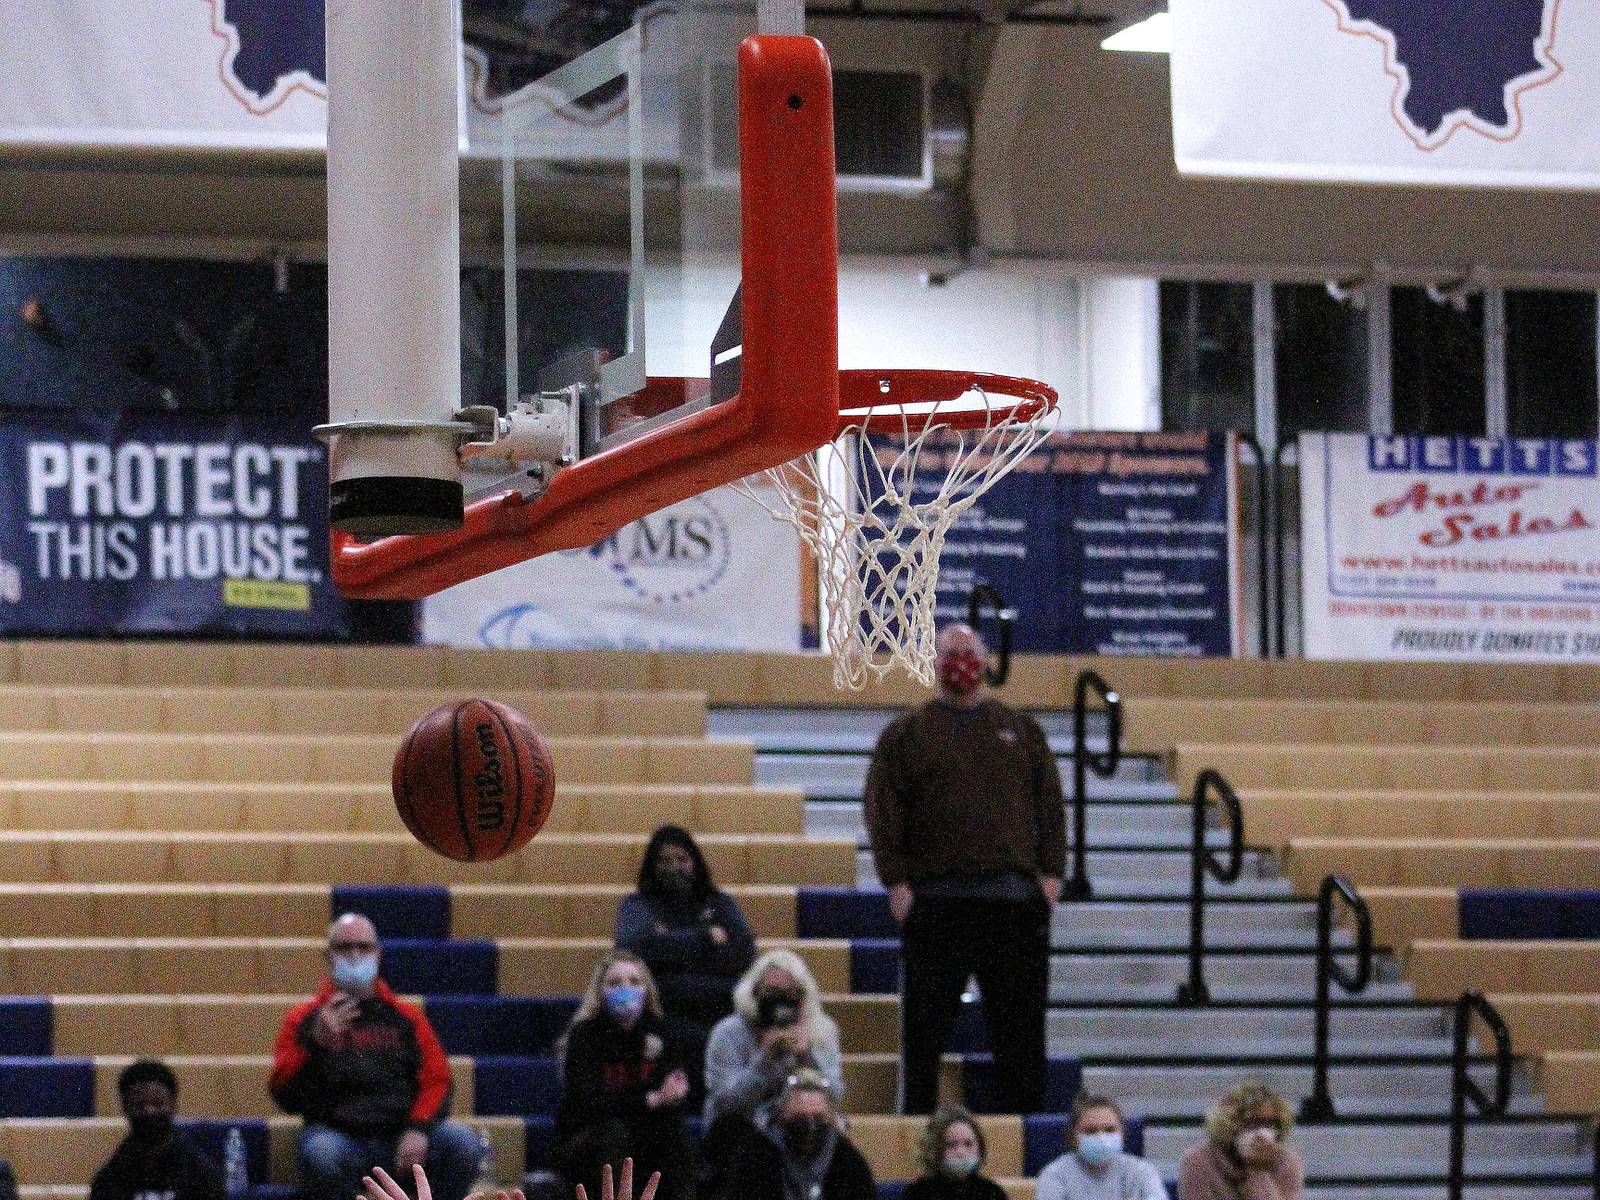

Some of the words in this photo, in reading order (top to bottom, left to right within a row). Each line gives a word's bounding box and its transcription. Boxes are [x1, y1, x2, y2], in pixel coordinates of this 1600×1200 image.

[1371, 437, 1590, 472] HETTS
[28, 442, 308, 518] PROTECT
[1372, 480, 1540, 518] Auto
[1419, 508, 1594, 547] Sales
[29, 523, 139, 580] THIS
[150, 523, 322, 582] HOUSE.
[1392, 629, 1477, 651] PROUDLY
[1482, 631, 1566, 653] DONATES
[475, 722, 504, 832] Wilson
